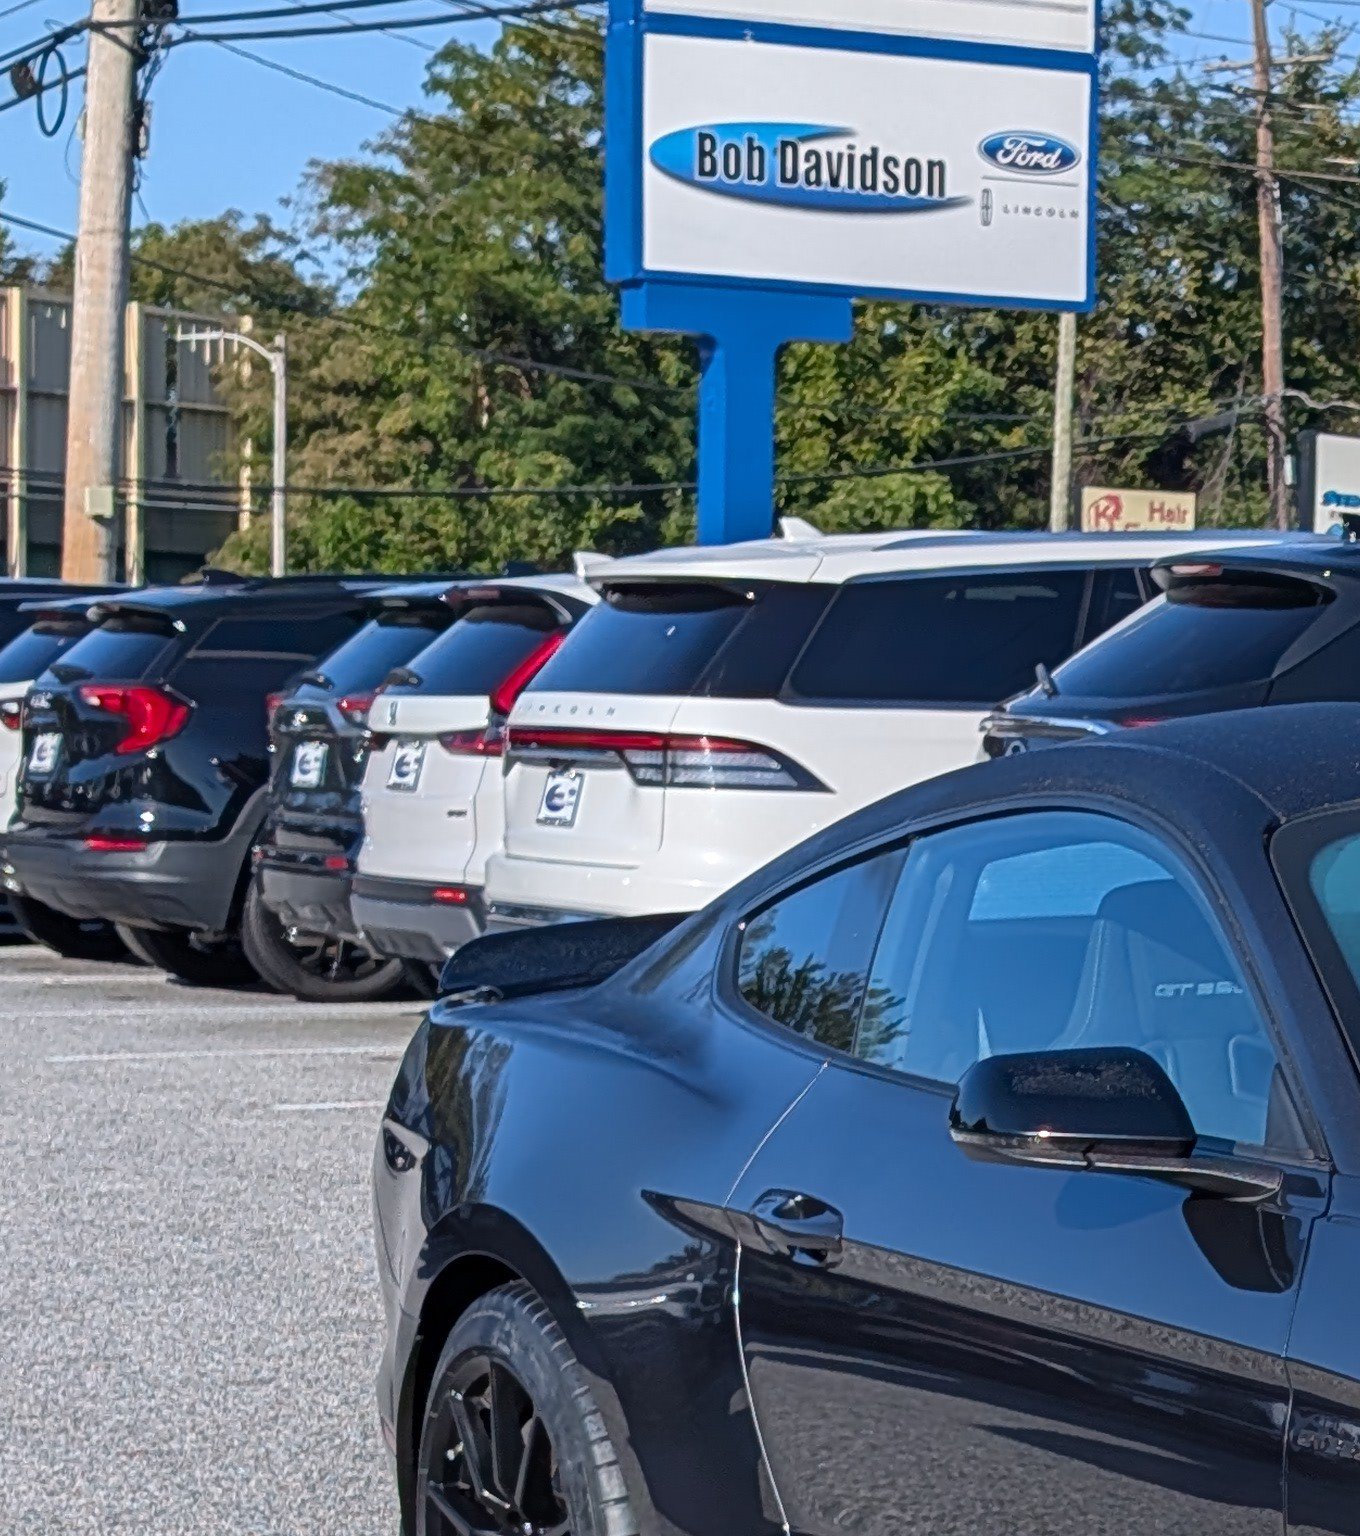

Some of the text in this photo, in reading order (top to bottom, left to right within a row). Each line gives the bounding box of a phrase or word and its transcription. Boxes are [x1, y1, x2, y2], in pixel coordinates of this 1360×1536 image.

[697, 132, 946, 197] Bob Davidson
[996, 136, 1062, 168] Ford
[1002, 204, 1079, 219] LINCOLN
